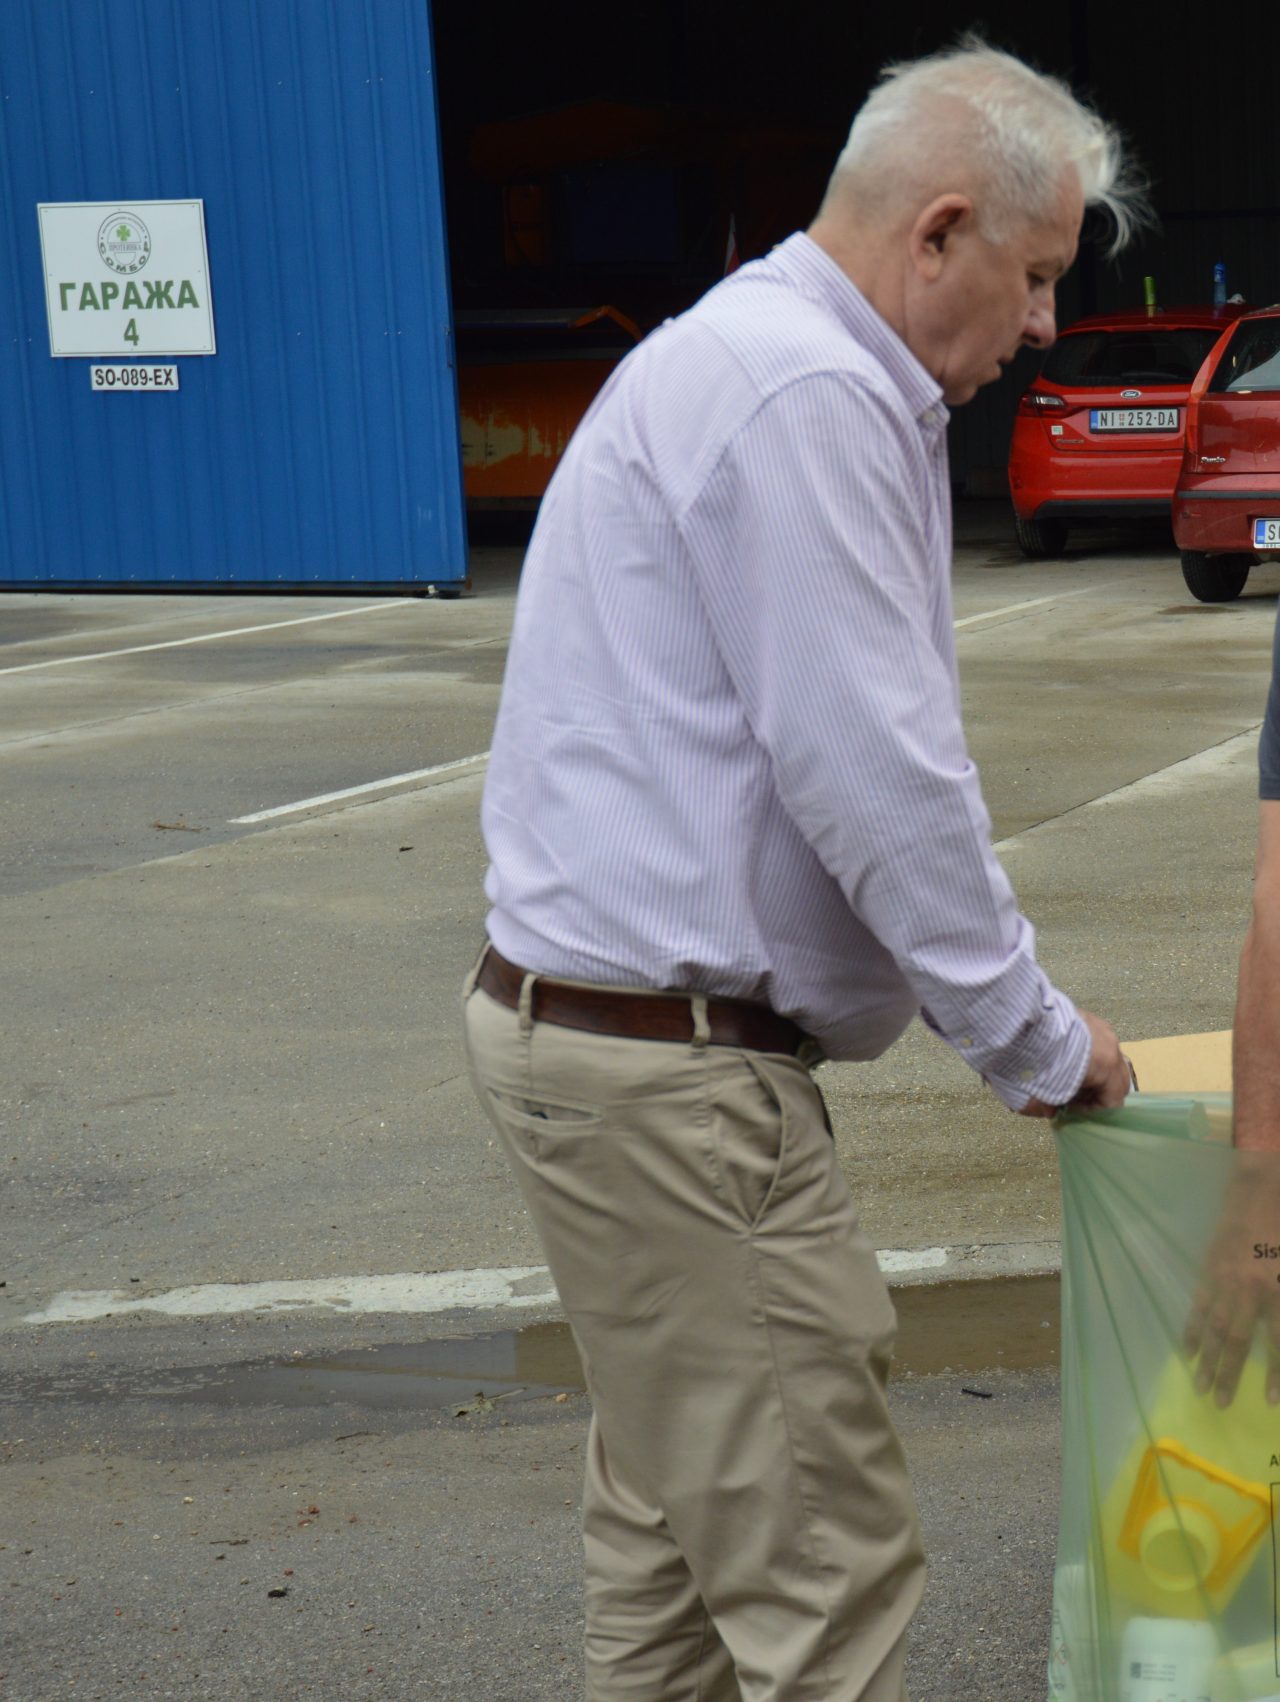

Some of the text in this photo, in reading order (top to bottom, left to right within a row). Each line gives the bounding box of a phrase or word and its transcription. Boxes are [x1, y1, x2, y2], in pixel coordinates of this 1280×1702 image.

[59, 280, 200, 311] ГАРАЖА
[124, 318, 139, 346] 4
[95, 368, 174, 386] SO-089-EX
[1100, 412, 1115, 427] NI
